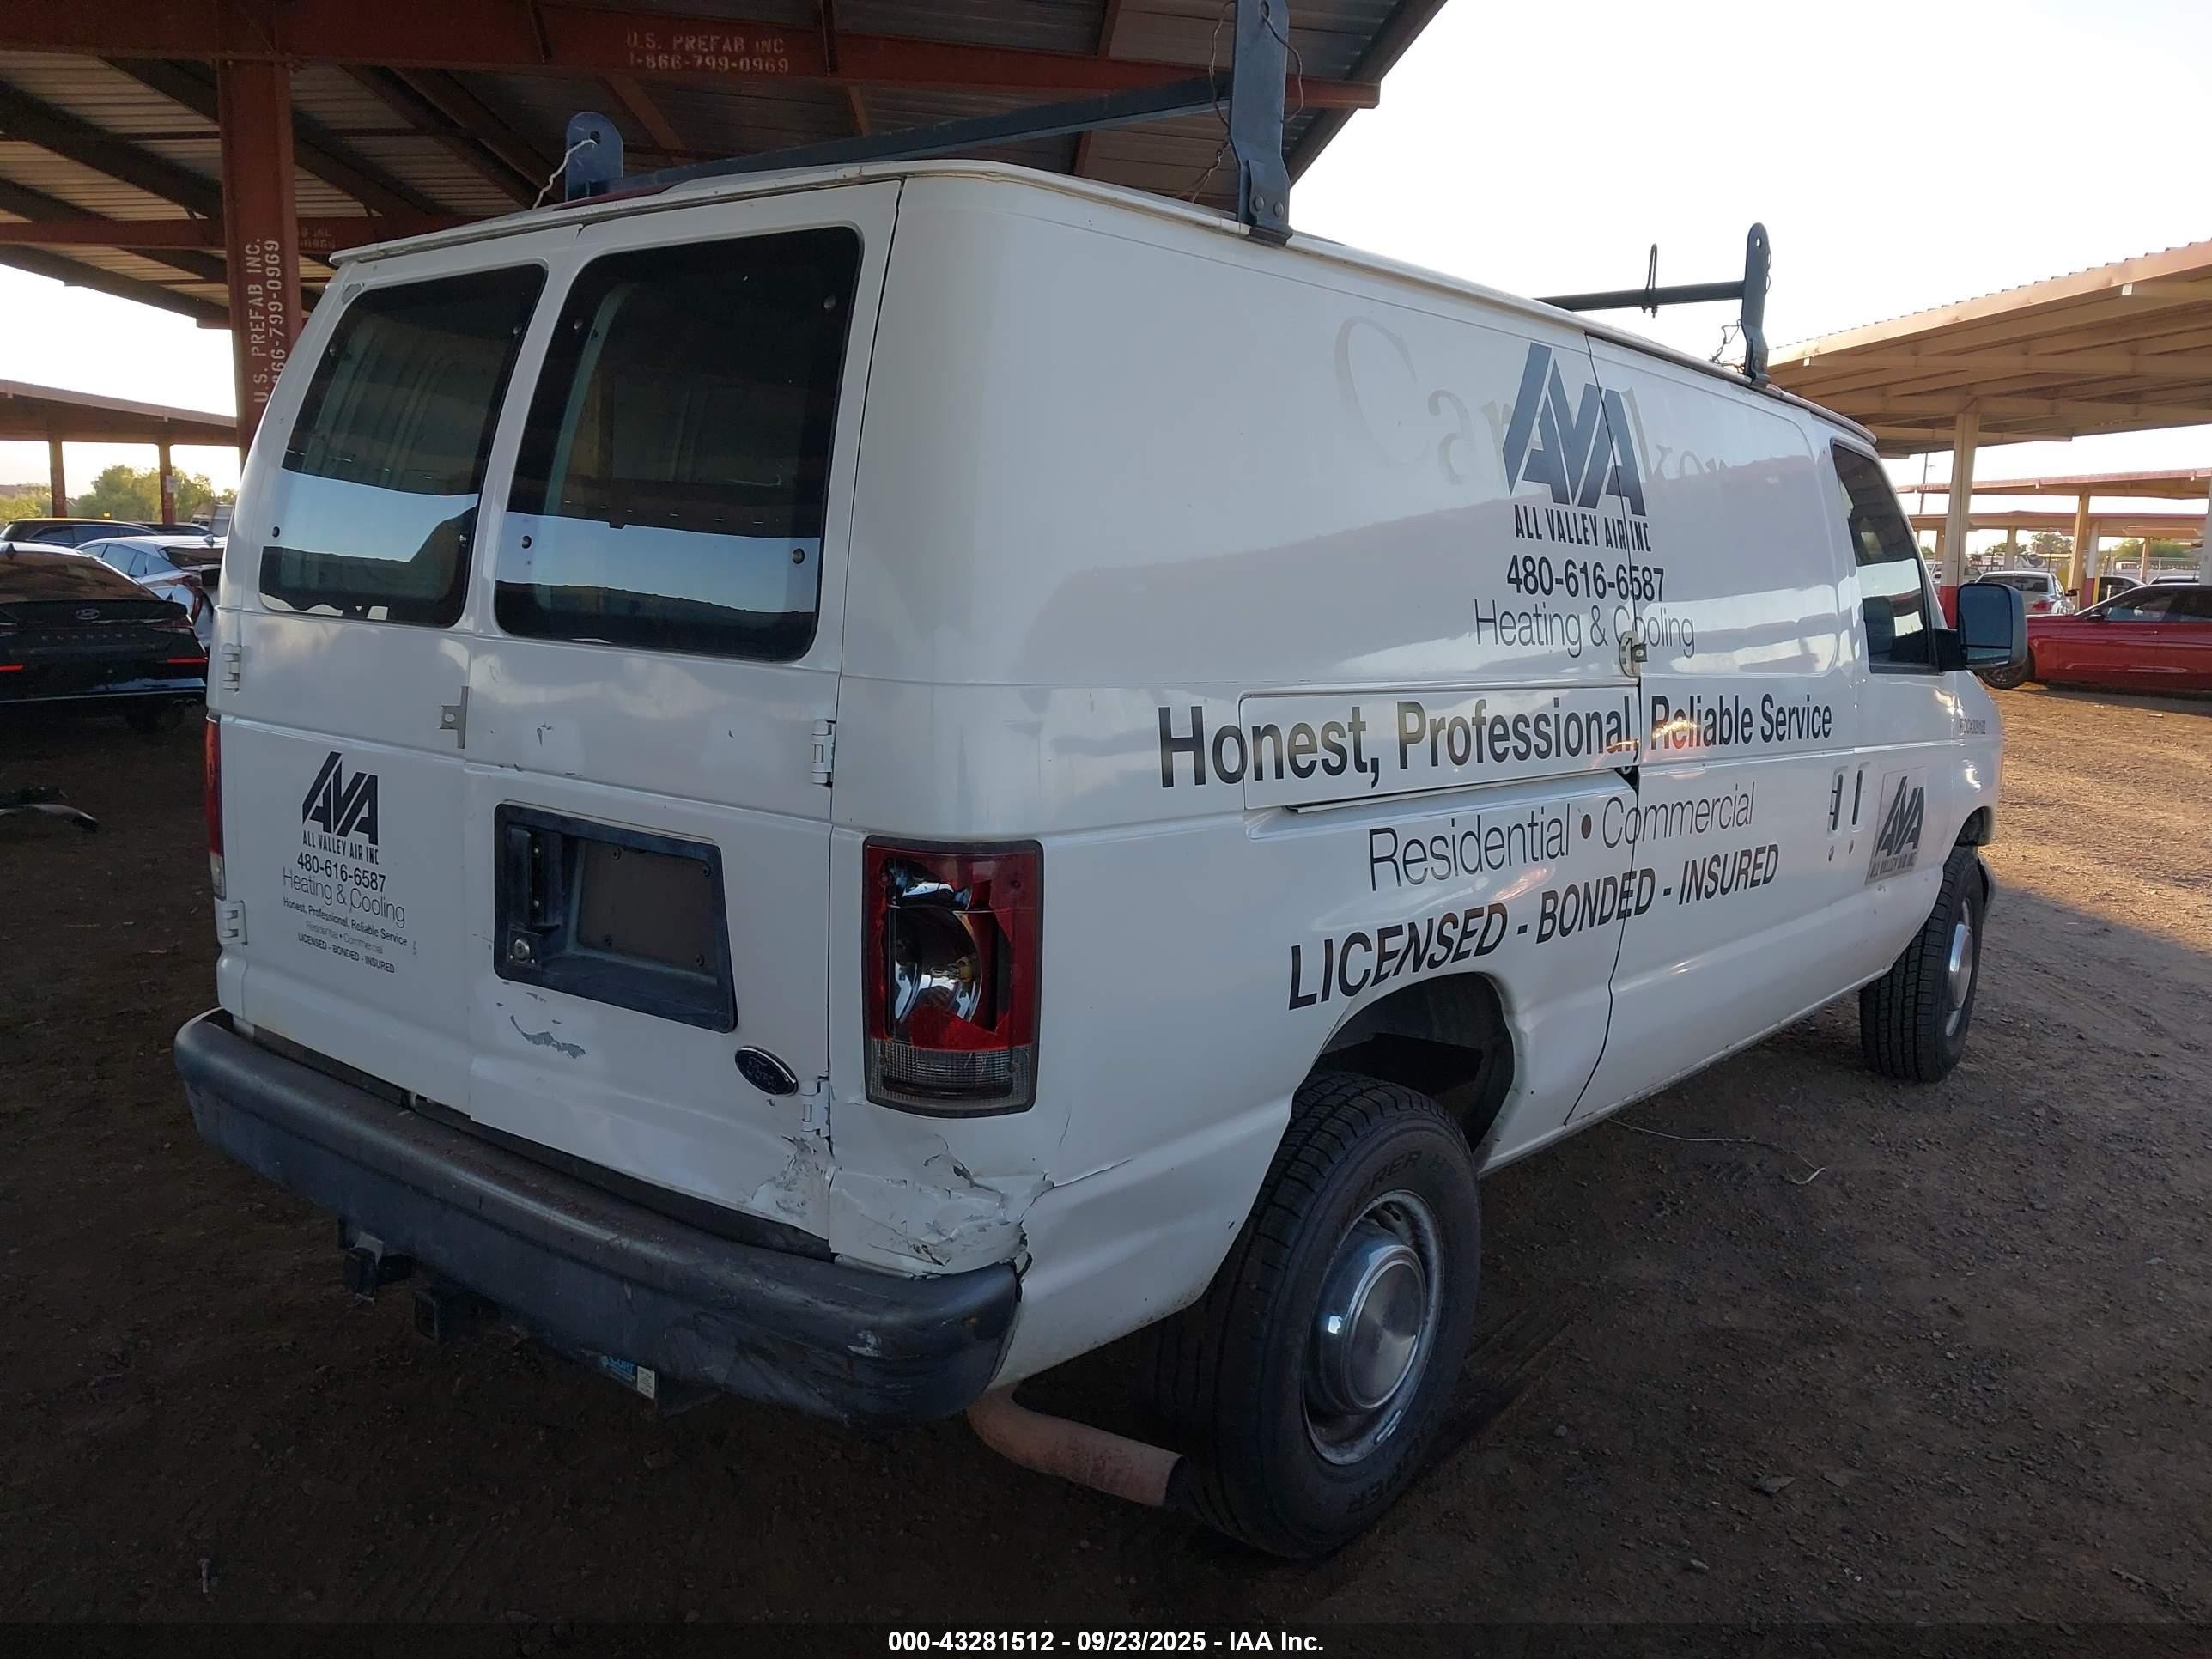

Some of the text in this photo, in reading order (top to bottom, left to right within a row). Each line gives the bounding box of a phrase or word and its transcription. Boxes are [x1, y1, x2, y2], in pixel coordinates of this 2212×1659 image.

[627, 31, 661, 50] U.S.
[672, 34, 745, 53] PREFAB
[629, 52, 789, 73] 1-866-799-0969
[246, 238, 268, 403] U.S. PREFAB INC.
[1514, 504, 1651, 552] ALL VALLEY AIR INC
[1507, 554, 1664, 602] 480-616-6587
[1474, 599, 1695, 659] Heating & Cooling
[1158, 693, 1832, 788] Honest, Professional, Reliable Service
[302, 830, 380, 866] ALL VALLEY AIR INC
[1369, 781, 1755, 892] Residential Commercial
[297, 851, 386, 893] 480-616-6587
[283, 866, 405, 929] Heating & Cooling
[308, 905, 350, 929] Professional,
[351, 919, 379, 937] Reliable
[380, 927, 408, 946] Service
[1288, 902, 1508, 1011] LICENSED
[1535, 867, 1656, 945] BONDED
[1678, 842, 1780, 906] INSURED
[297, 933, 328, 951] LICENSED
[332, 944, 360, 962] BONDED
[364, 955, 395, 974] INSURED
